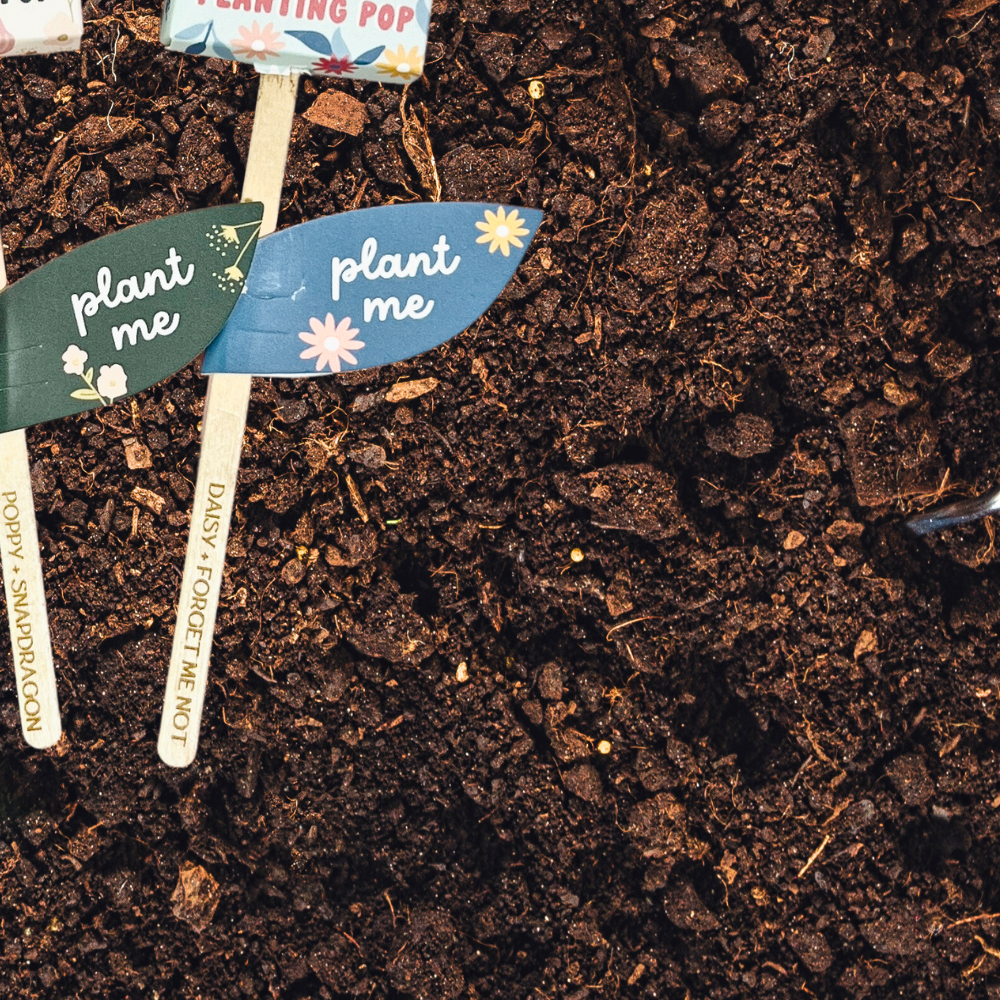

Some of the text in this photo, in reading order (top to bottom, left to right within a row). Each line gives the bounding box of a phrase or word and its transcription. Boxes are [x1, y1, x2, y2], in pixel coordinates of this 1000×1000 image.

[359, 1, 414, 33] POP
[70, 246, 195, 337] plant
[332, 233, 461, 301] plant
[111, 310, 181, 351] me
[364, 294, 434, 323] me
[1, 491, 26, 561] POPPY
[201, 482, 225, 550] DAISY
[182, 564, 212, 657] FORGET
[10, 580, 43, 733] SNAPDRAGON
[177, 661, 199, 693] ME
[170, 697, 193, 748] NOT
